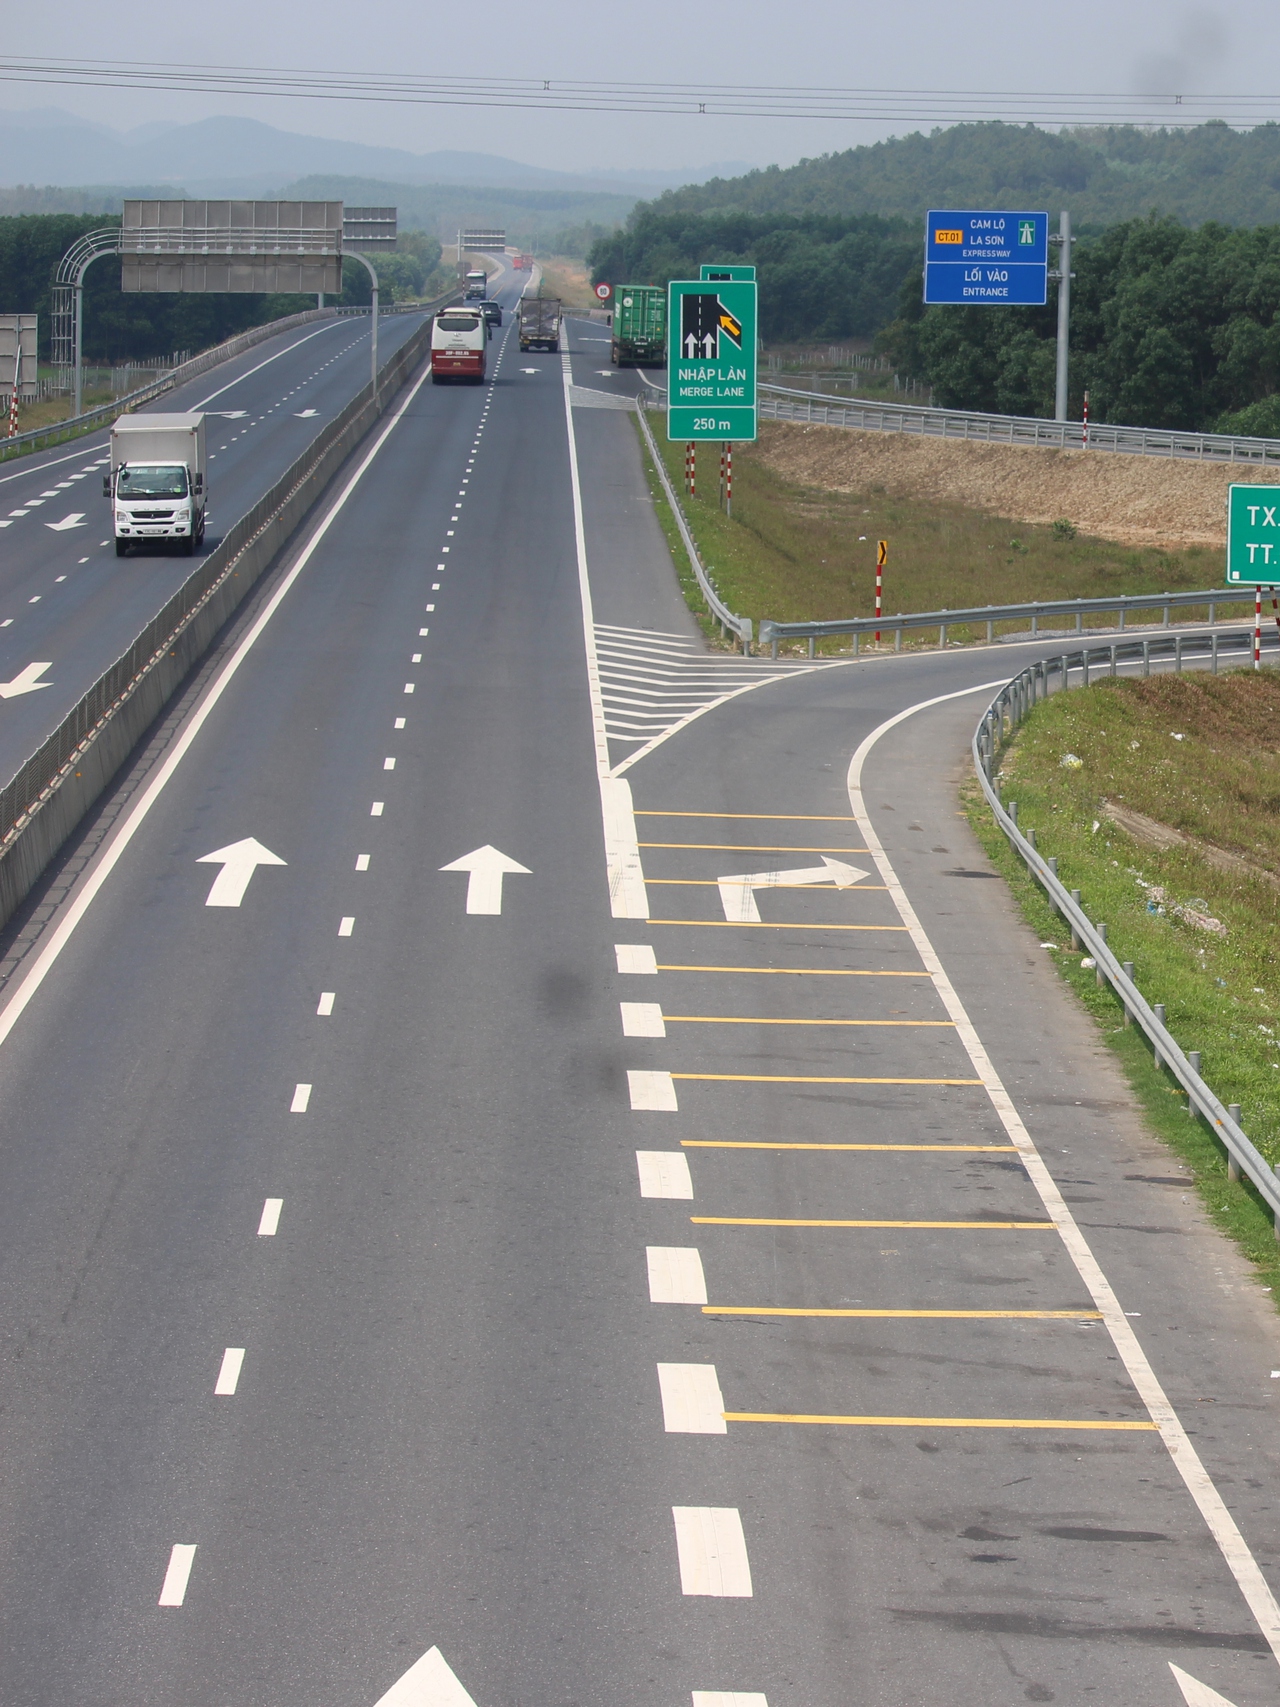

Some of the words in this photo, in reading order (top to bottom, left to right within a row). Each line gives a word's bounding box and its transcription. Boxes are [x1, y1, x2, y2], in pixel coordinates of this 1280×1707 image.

[970, 219, 991, 229] CAM
[994, 219, 1005, 230] LỘ
[938, 232, 959, 242] CT.01
[970, 236, 982, 245] LA
[985, 236, 1004, 245] SƠN
[962, 249, 1011, 258] EXPRESSWAY
[964, 267, 982, 282] LỐI
[986, 267, 1008, 282] VÀO
[963, 287, 1008, 296] ENTRANCE
[678, 366, 716, 383] NHẬP
[718, 366, 746, 380] LÀN
[680, 387, 713, 396] MERGE
[717, 387, 744, 396] LANE
[693, 418, 715, 430] 250
[718, 421, 731, 431] m
